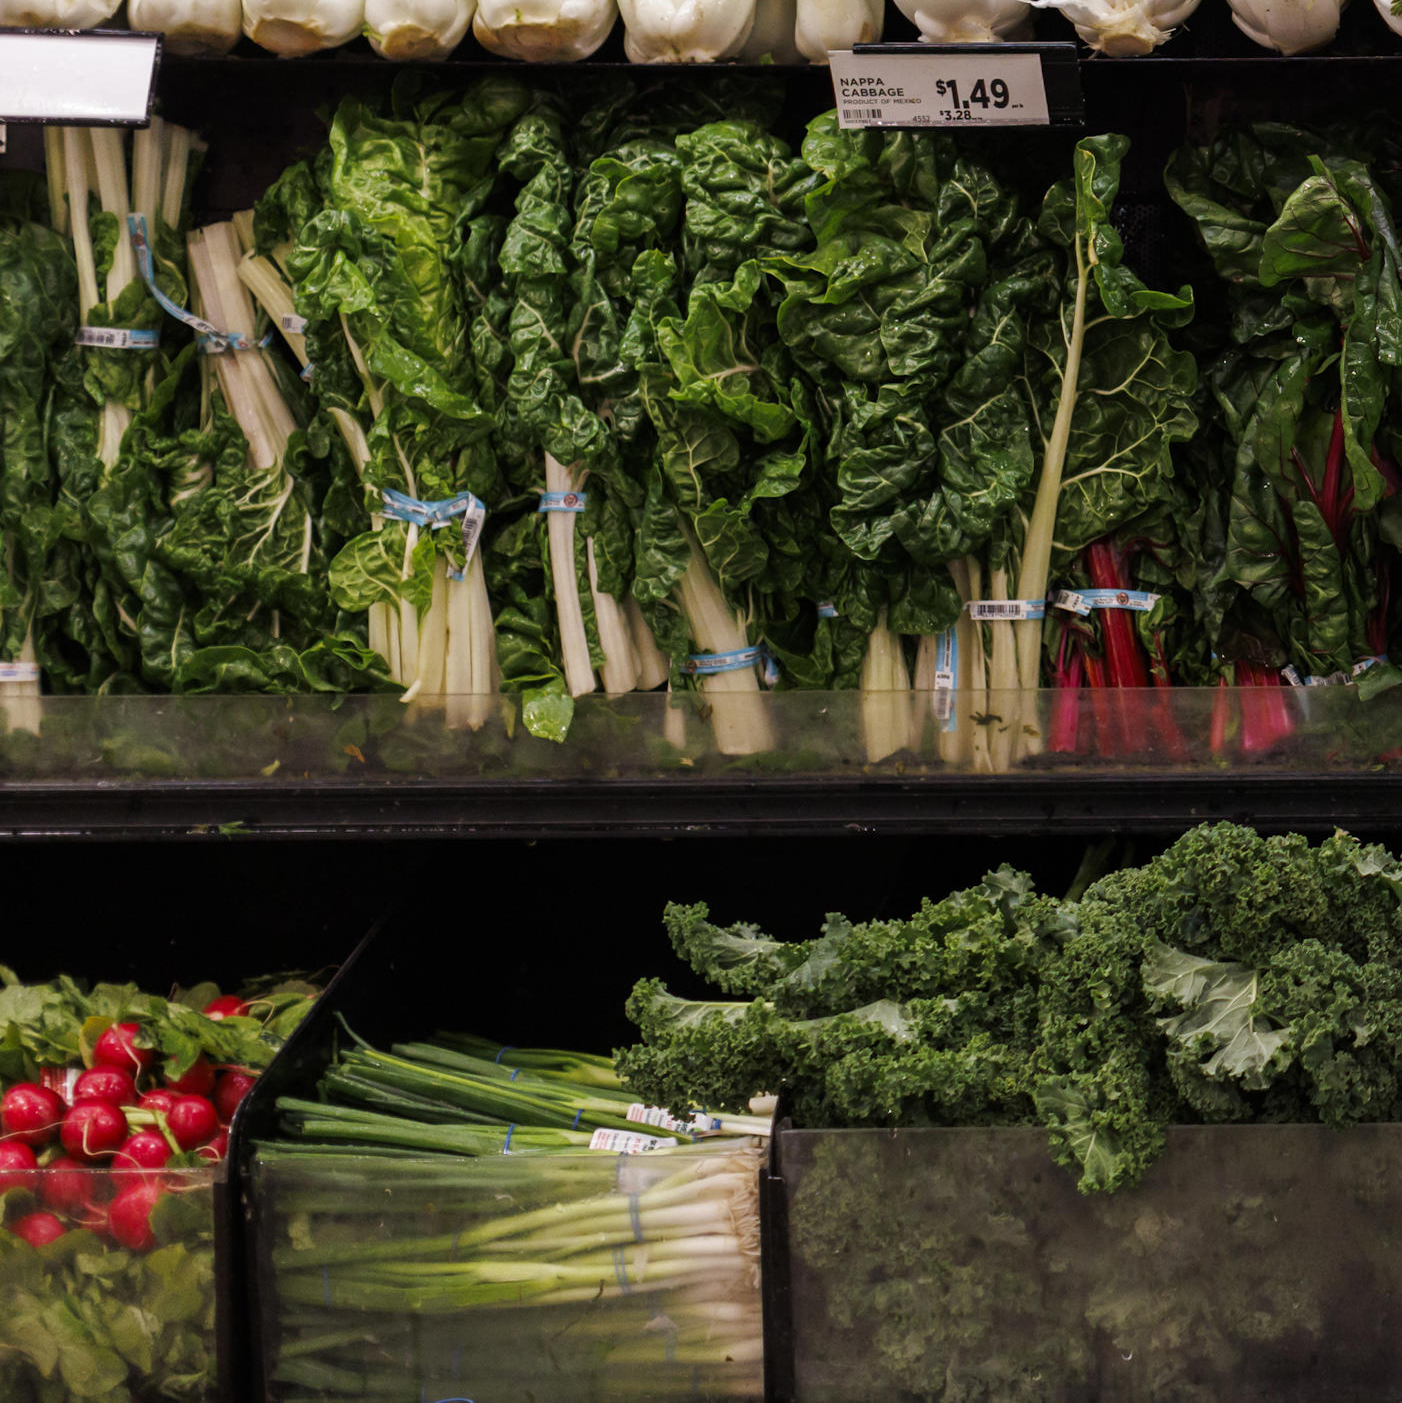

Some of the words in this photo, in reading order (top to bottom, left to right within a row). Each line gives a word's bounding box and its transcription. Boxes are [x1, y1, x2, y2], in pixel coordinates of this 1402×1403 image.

[840, 77, 885, 86] NAPPA
[842, 88, 904, 97] CABBAGE
[935, 78, 1009, 109] $1.49
[939, 110, 971, 121] $3.28
